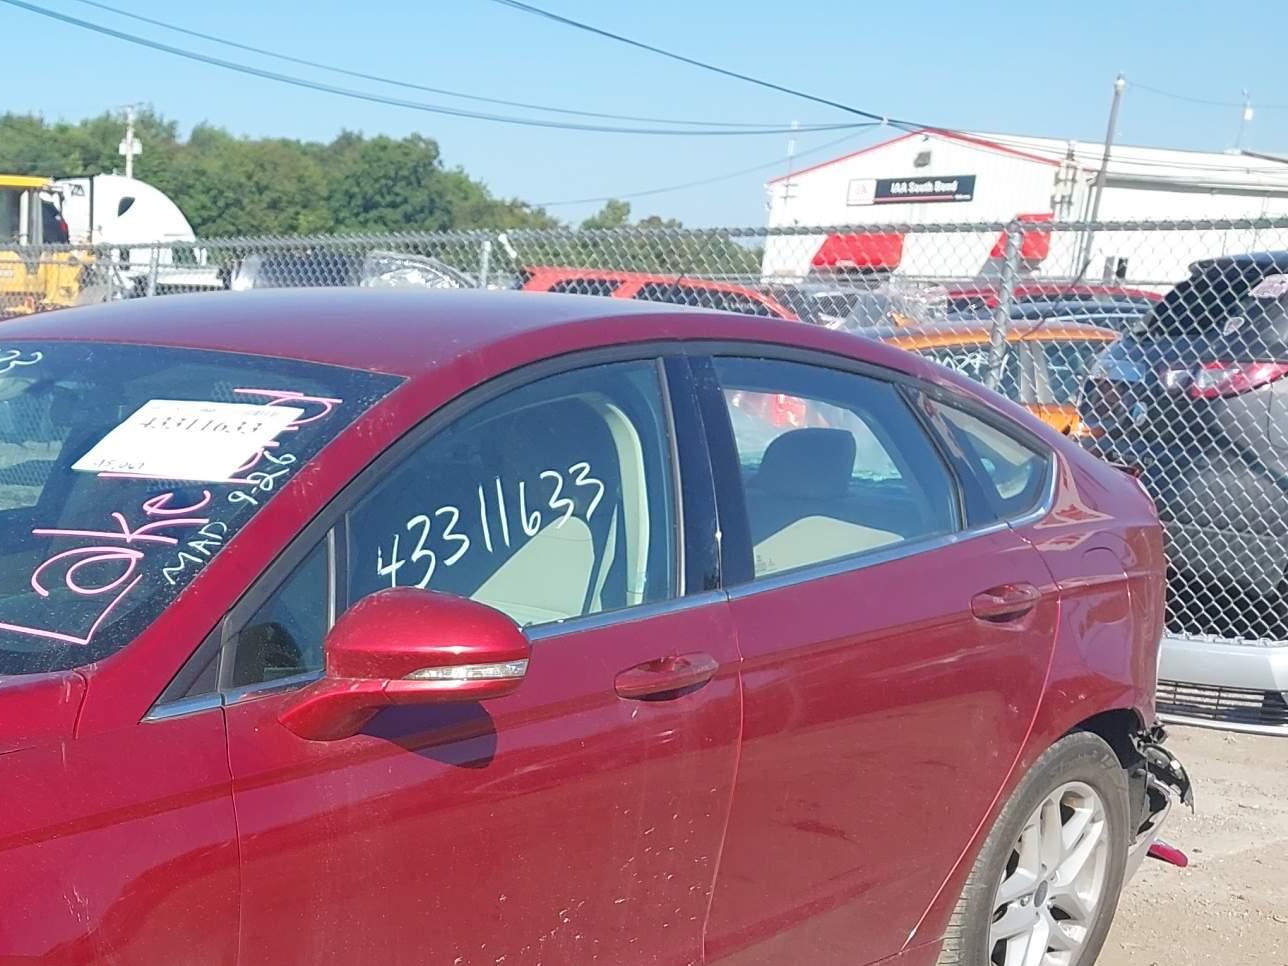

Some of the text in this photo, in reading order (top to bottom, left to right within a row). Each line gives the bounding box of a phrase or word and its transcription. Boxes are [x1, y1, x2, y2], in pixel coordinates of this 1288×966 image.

[162, 519, 229, 586] MAD
[226, 451, 298, 507] 9-26
[377, 461, 605, 588] 43311633
